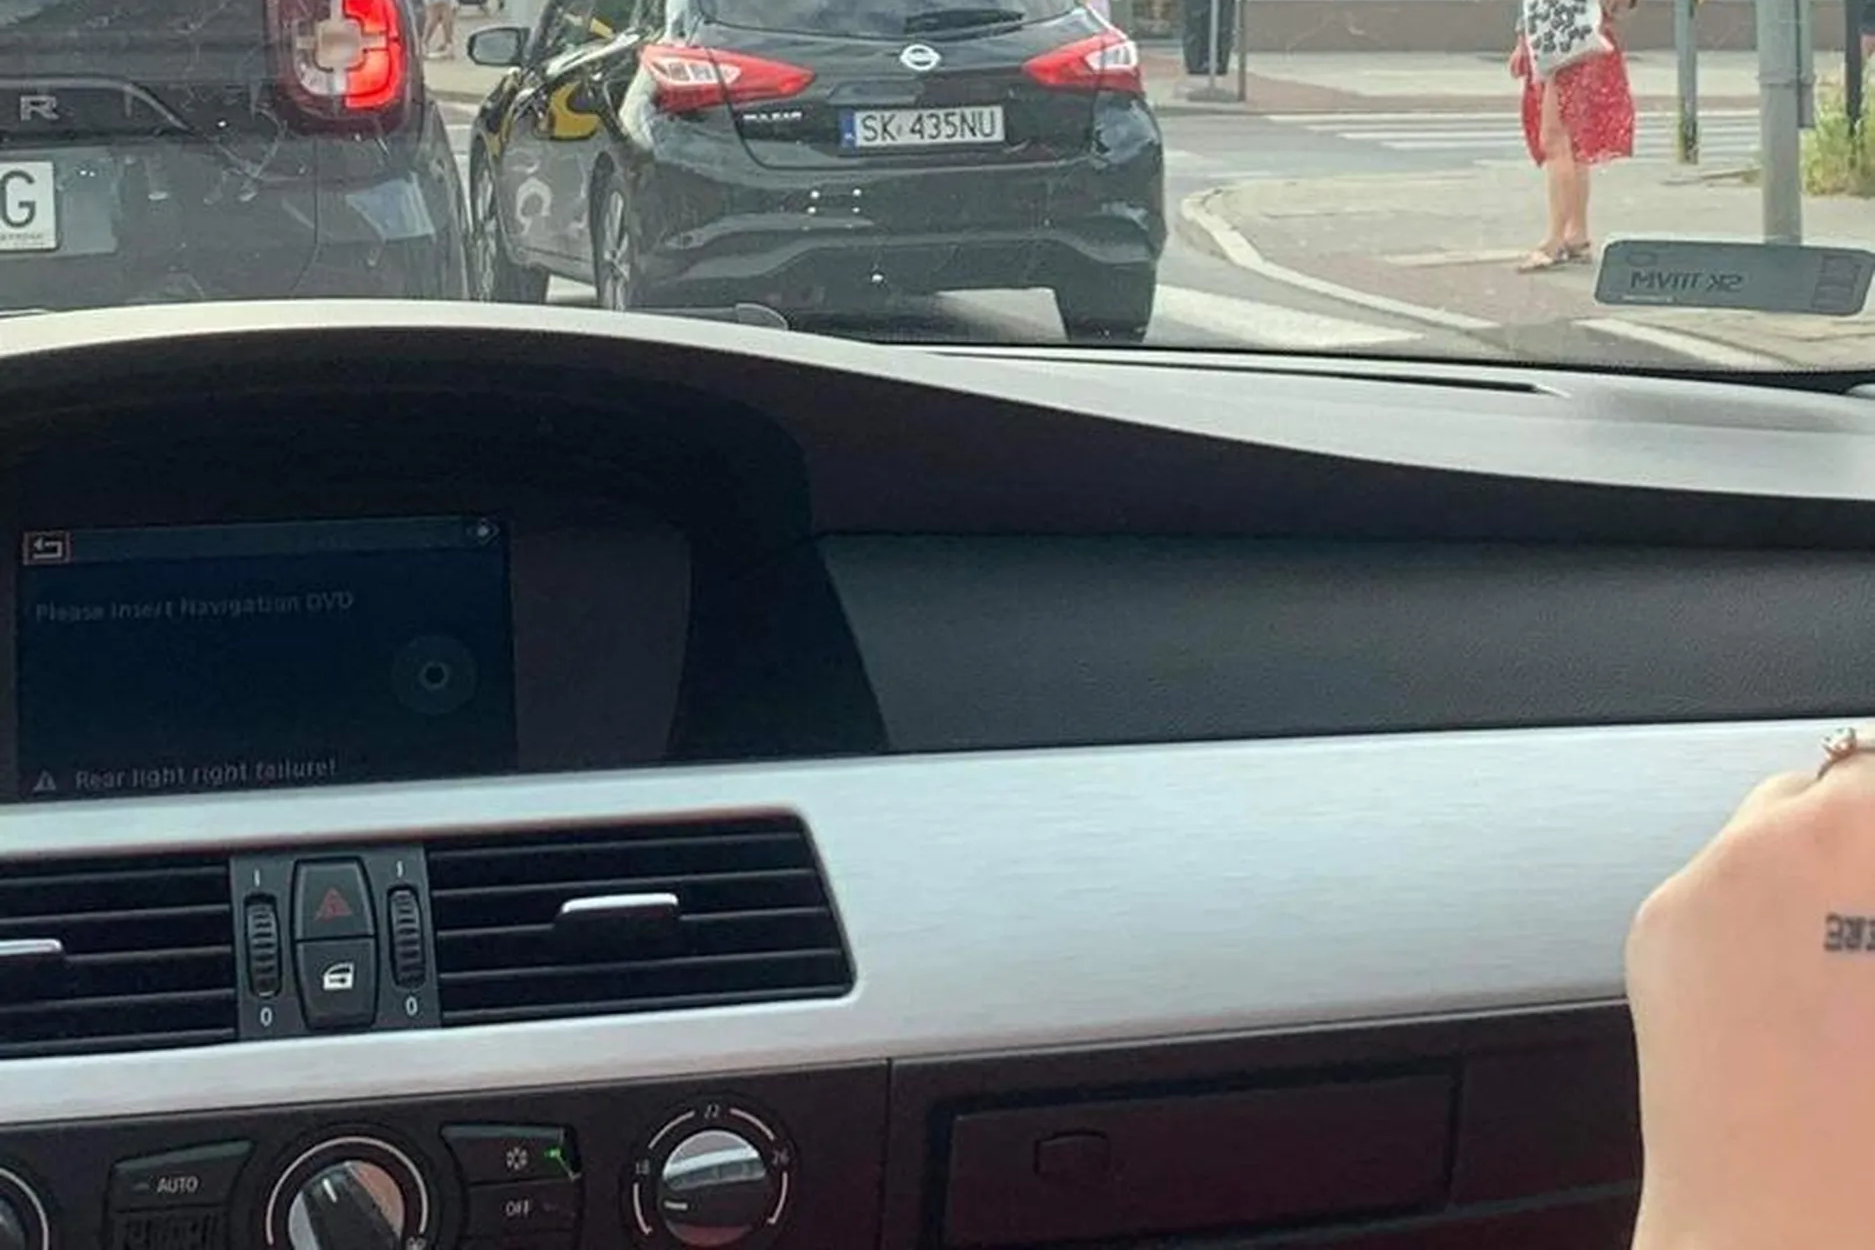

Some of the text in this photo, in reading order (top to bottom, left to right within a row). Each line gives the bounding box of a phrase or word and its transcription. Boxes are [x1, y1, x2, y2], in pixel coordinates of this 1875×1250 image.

[862, 110, 996, 142] SK 435NU
[36, 602, 103, 622] Please
[181, 595, 301, 619] Navigation
[306, 591, 354, 613] DVD
[76, 769, 124, 790] Rear
[132, 766, 186, 788] light
[192, 763, 248, 787] right
[157, 1176, 199, 1193] AUTO
